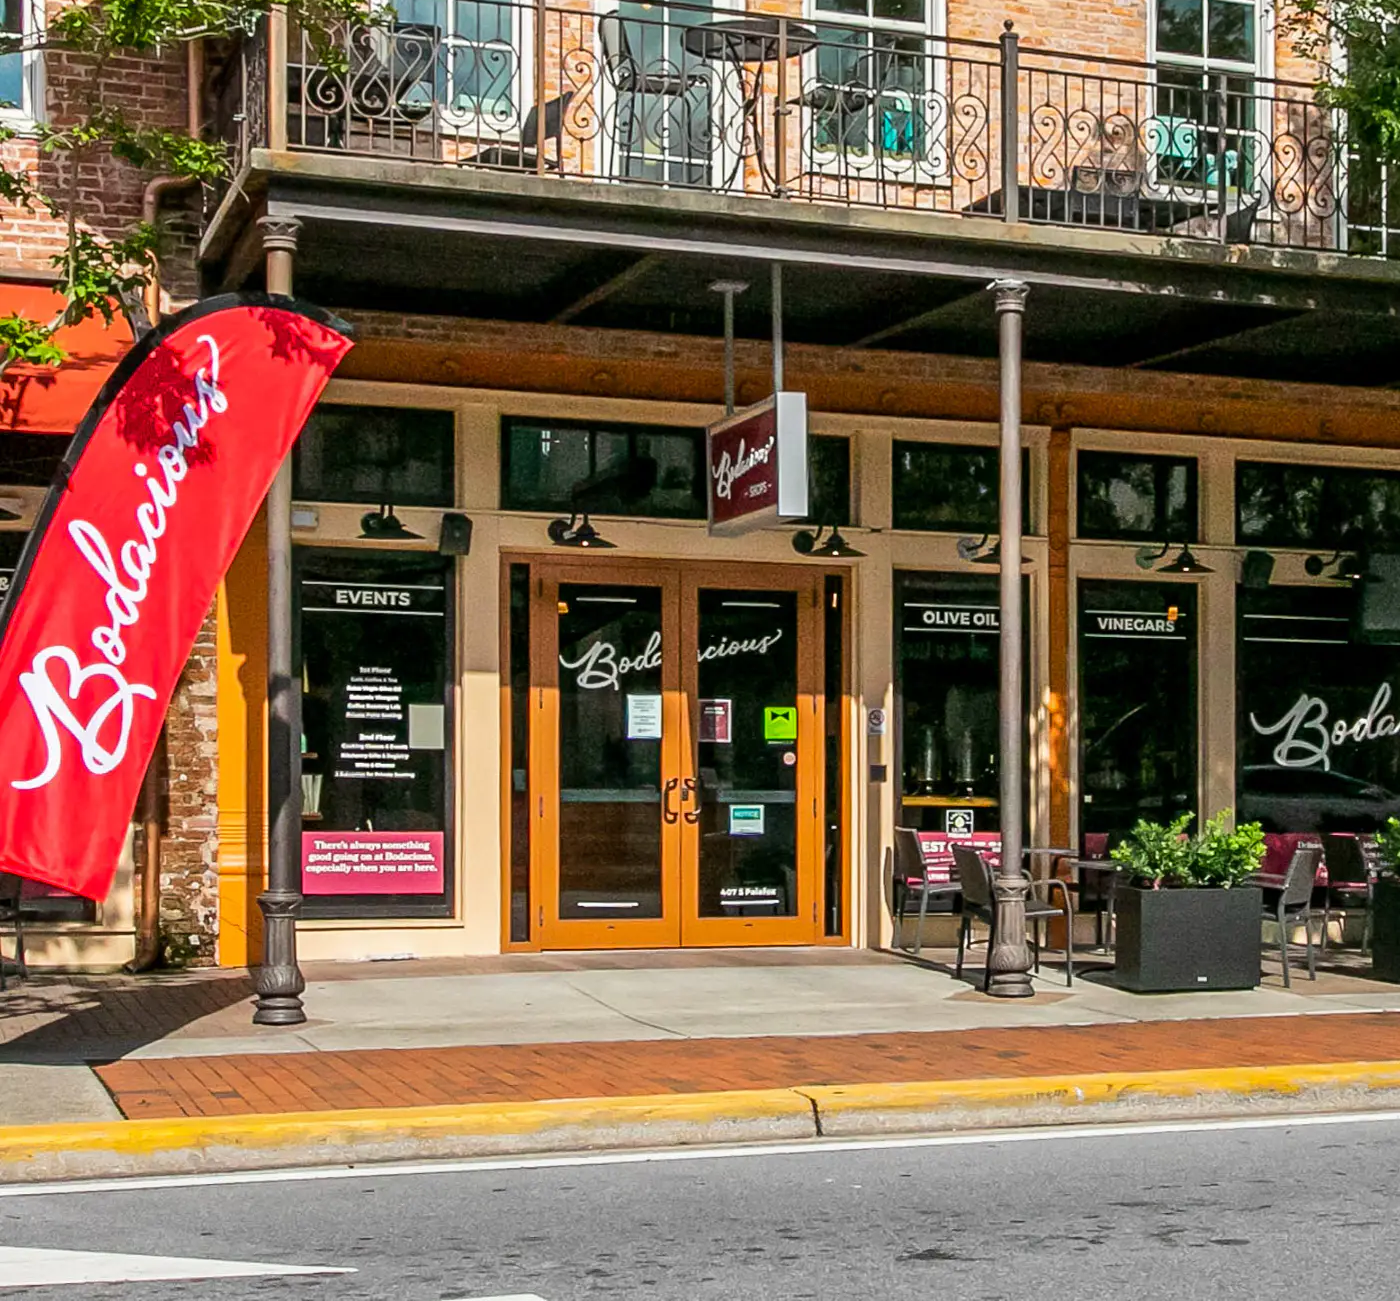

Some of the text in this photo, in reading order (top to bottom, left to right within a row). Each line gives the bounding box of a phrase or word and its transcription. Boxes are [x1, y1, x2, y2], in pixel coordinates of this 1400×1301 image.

[11, 334, 229, 790] Bodacious
[335, 589, 411, 607] EVENTS
[922, 610, 1000, 627] OLIVE OIL
[1097, 616, 1176, 633] VINEGARS
[1249, 681, 1400, 772] Boda
[314, 840, 430, 851] There's always something
[308, 852, 332, 863] good
[333, 852, 359, 863] going
[374, 853, 384, 861] at
[305, 863, 352, 874] especially
[353, 863, 378, 872] when
[379, 864, 397, 874] you
[414, 863, 438, 872] here.
[720, 887, 738, 896] 407
